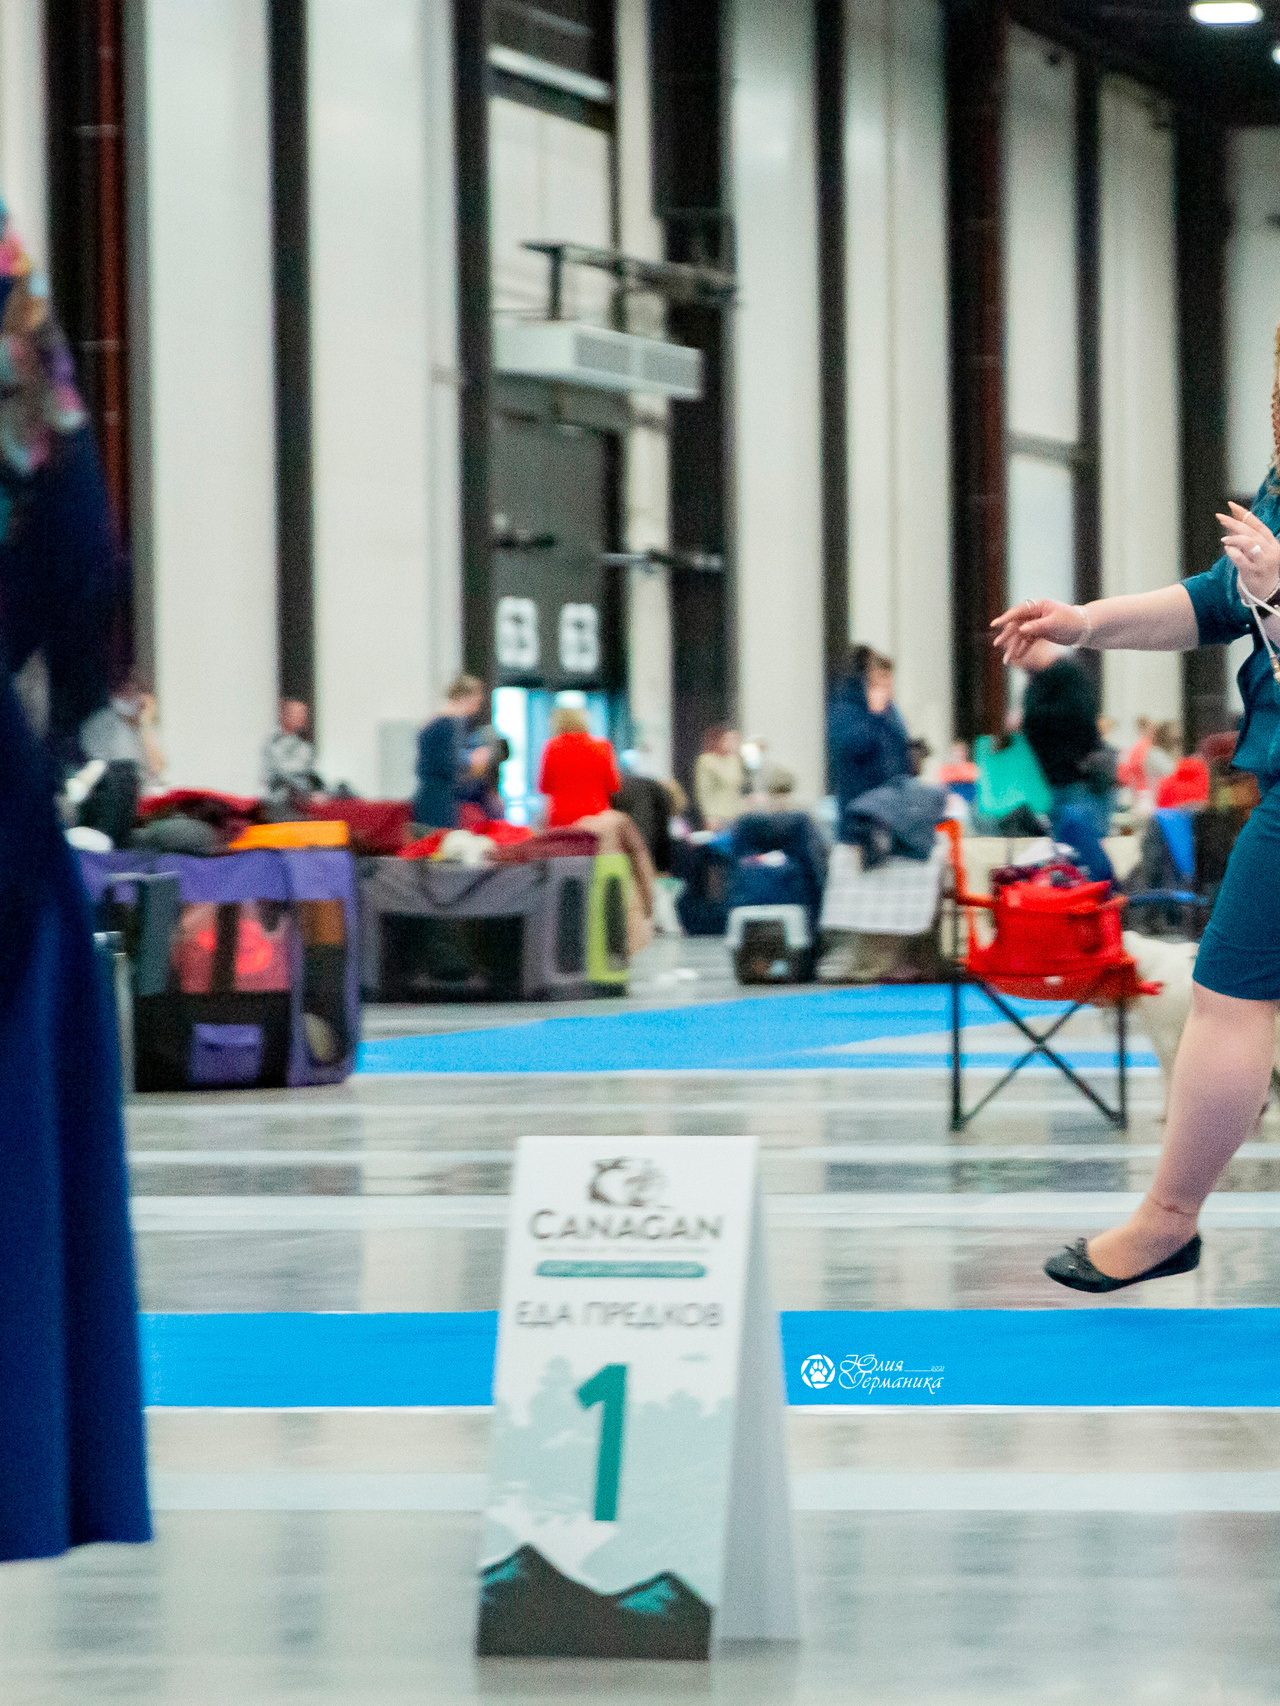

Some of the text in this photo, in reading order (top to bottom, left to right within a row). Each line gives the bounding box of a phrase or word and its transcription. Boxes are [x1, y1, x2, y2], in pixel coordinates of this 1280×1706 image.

[530, 1208, 724, 1240] CANAGAN
[516, 1301, 724, 1328] ЕДА ПРЕДКОВ
[575, 1363, 628, 1522] 1
